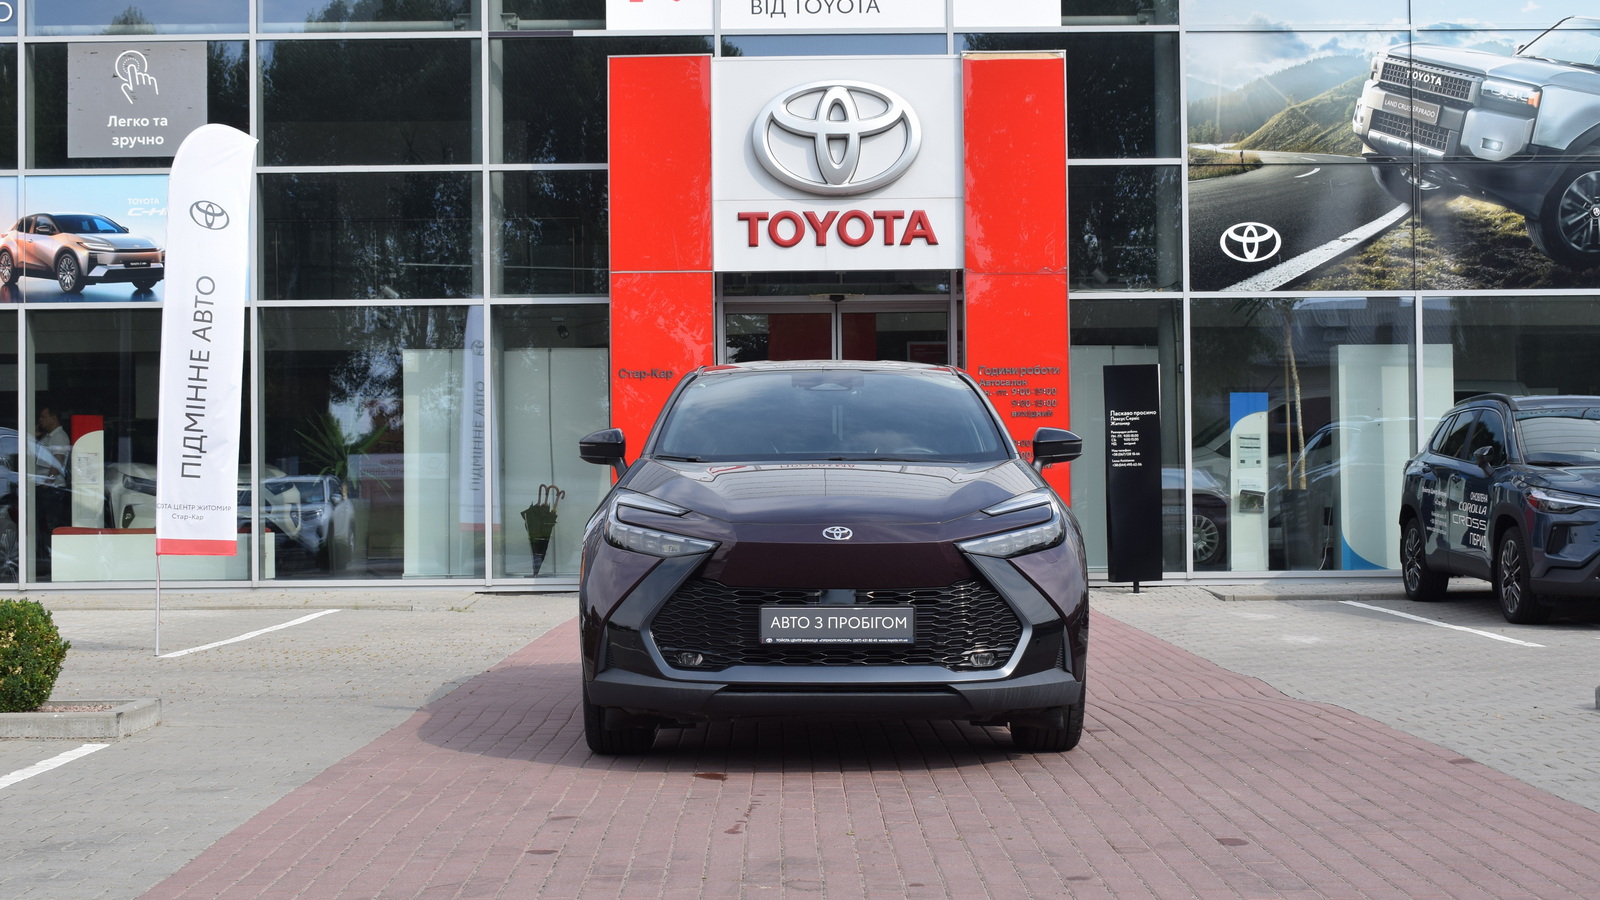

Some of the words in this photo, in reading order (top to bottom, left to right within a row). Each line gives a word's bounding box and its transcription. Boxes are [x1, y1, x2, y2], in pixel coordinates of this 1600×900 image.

[751, 0, 786, 18] ВІД
[796, 0, 880, 14] TOYOTA
[1406, 70, 1441, 86] TOYOTA
[1385, 99, 1397, 108] LAND
[1419, 107, 1436, 118] PRADO
[107, 115, 150, 127] Легко
[153, 117, 168, 127] та
[112, 135, 164, 148] зручно
[128, 207, 167, 216] C-H
[737, 209, 939, 248] TOYOTA
[192, 275, 216, 342] АВТО
[619, 368, 674, 380] Стар-Кар
[978, 365, 1018, 376] Години
[1020, 365, 1060, 376] роботи
[979, 379, 1028, 387] Автосалон
[181, 350, 210, 479] ПІДМІННЕ
[1012, 409, 1053, 418] вихідний
[173, 503, 196, 512] ЦЕНТР
[197, 503, 232, 511] ЖИТОМИР
[1458, 502, 1487, 515] COROLLA
[171, 513, 204, 521] Стар-Кар
[1453, 514, 1487, 530] CROSS
[770, 616, 810, 629] АВТО
[814, 616, 823, 629] З
[828, 616, 907, 629] ПРОБІГОМ
